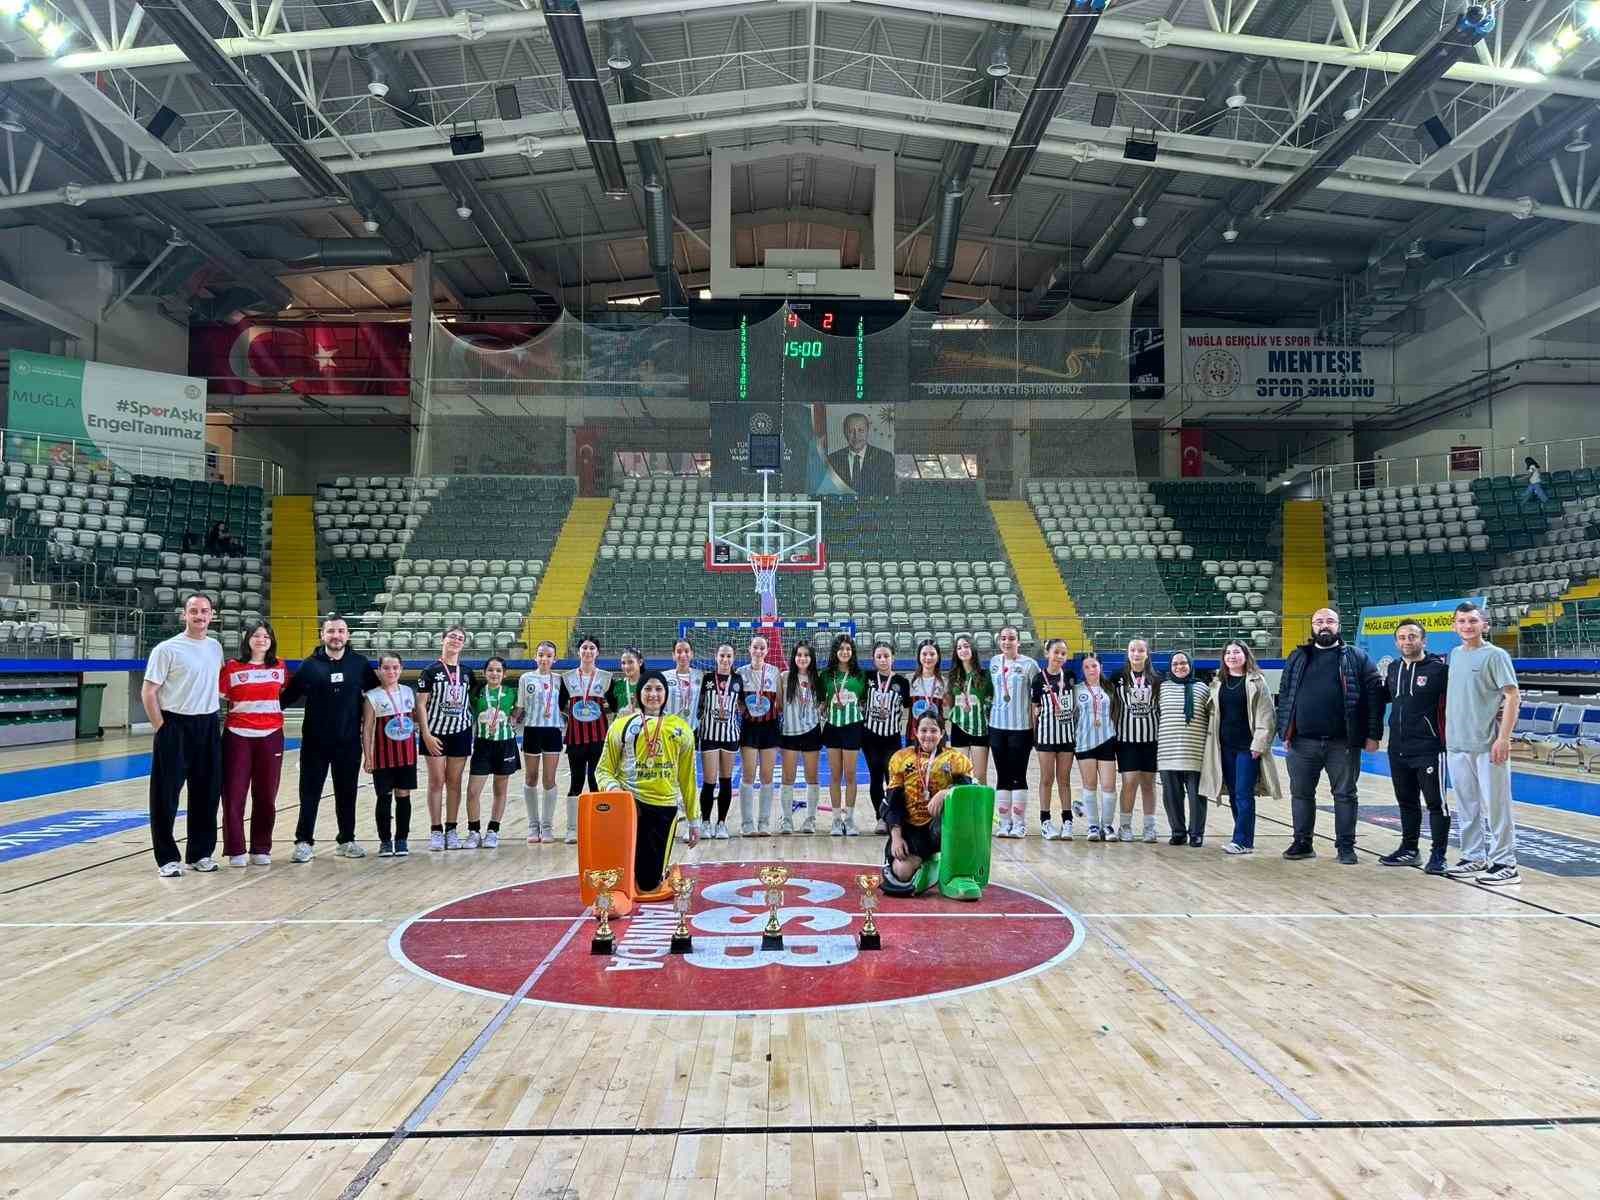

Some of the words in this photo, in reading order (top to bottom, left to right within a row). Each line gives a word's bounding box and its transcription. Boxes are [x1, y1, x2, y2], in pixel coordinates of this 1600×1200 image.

[788, 314, 798, 328] 4
[824, 314, 833, 328] 2
[785, 341, 822, 357] 15:00
[1187, 332, 1223, 347] MUĞLA
[1225, 332, 1267, 349] GENÇLİK
[1269, 335, 1282, 347] VE
[1284, 335, 1311, 347] SPOR
[1268, 350, 1362, 377] MENTEŞE
[1256, 378, 1304, 397] SPOR
[1307, 377, 1375, 397] SALONU
[13, 391, 76, 409] MUĞLA
[87, 414, 202, 440] EngelTanımaz
[1365, 618, 1383, 631] MUĞLA
[683, 877, 860, 970] GSB
